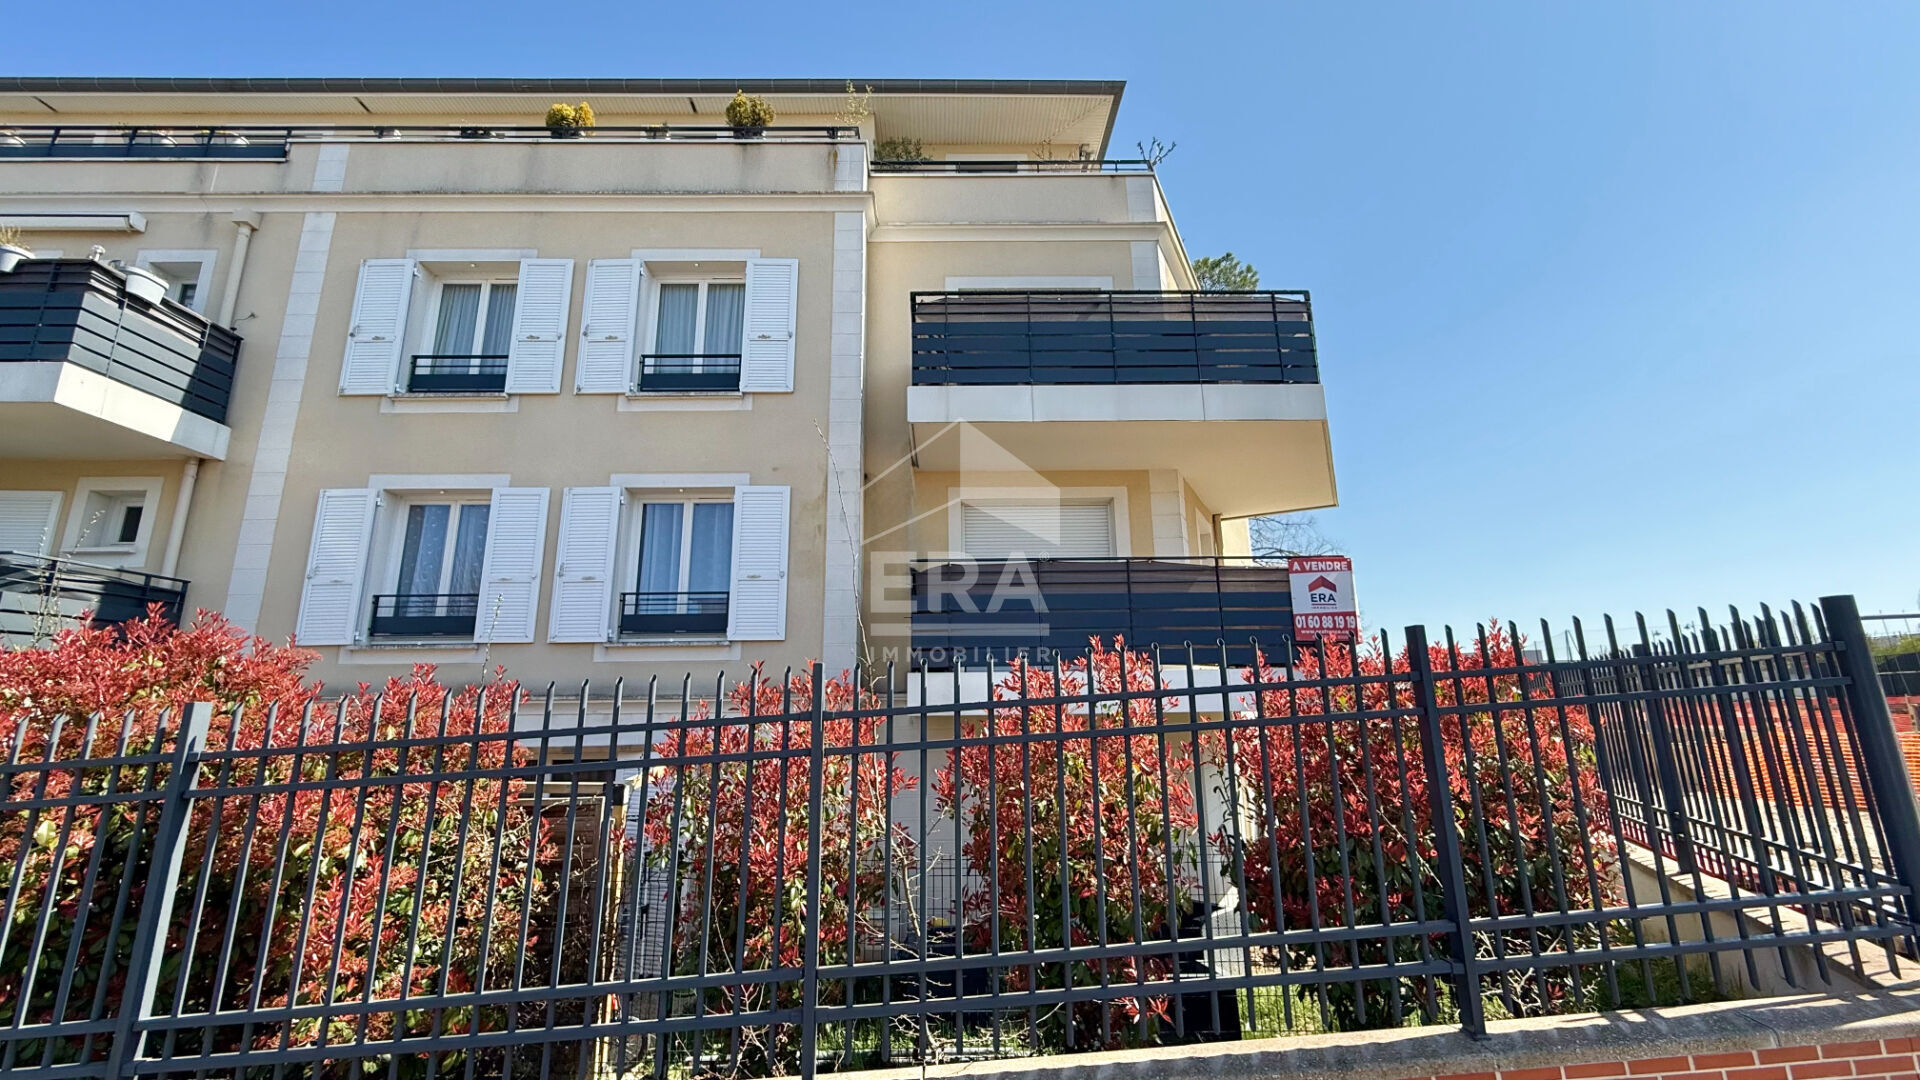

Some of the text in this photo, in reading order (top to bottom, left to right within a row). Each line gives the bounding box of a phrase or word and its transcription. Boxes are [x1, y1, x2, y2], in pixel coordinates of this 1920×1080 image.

[1293, 561, 1348, 571] A VENDRE
[1310, 593, 1337, 602] ERA
[1295, 615, 1356, 629] 01 60 88 19 19
